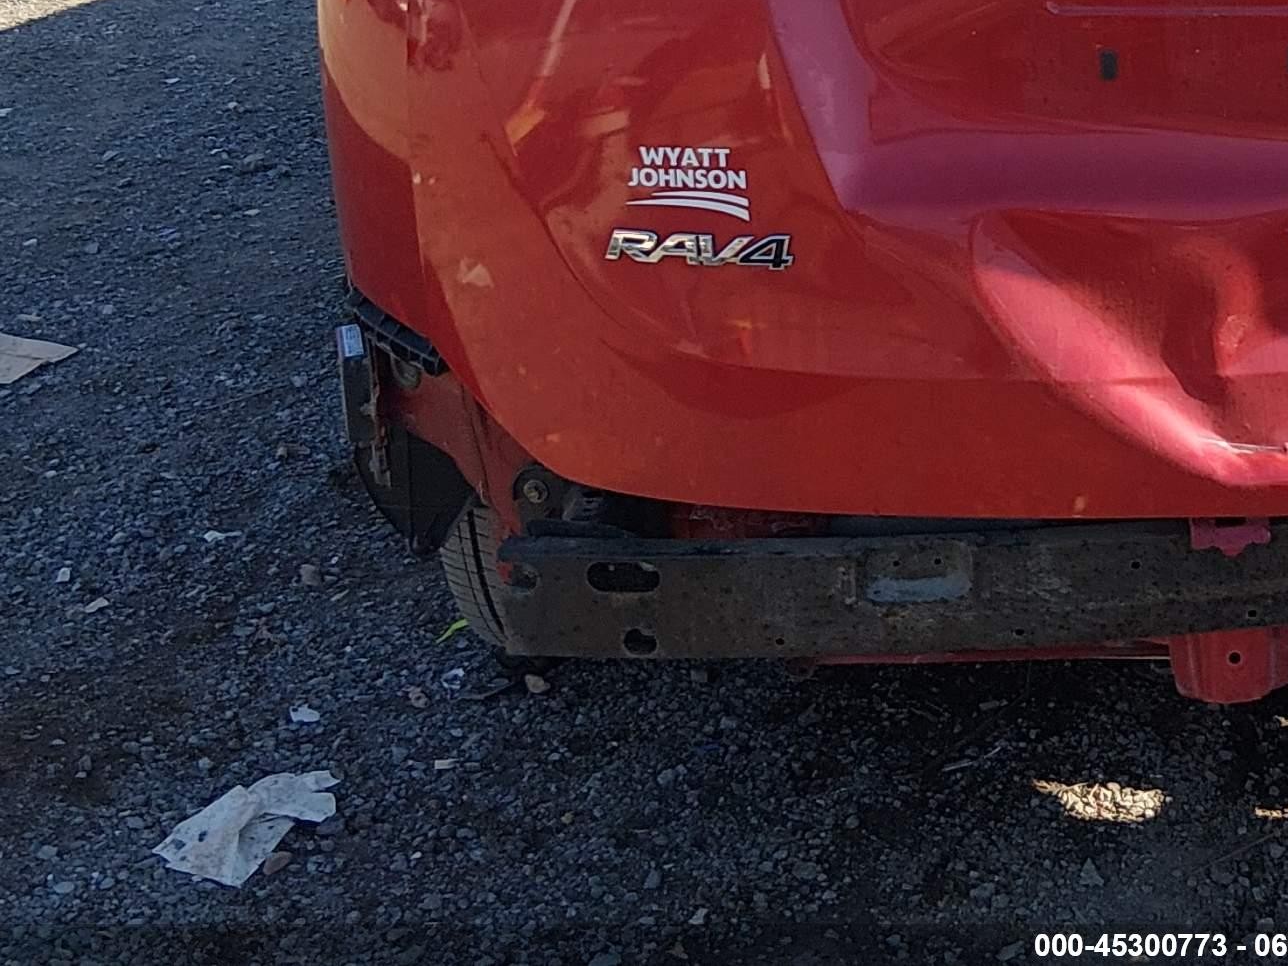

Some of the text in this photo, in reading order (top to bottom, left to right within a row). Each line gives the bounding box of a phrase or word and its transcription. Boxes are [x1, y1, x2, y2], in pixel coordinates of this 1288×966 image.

[639, 146, 730, 167] WYATT
[627, 169, 747, 189] JOHNSON
[605, 229, 794, 270] RAV4
